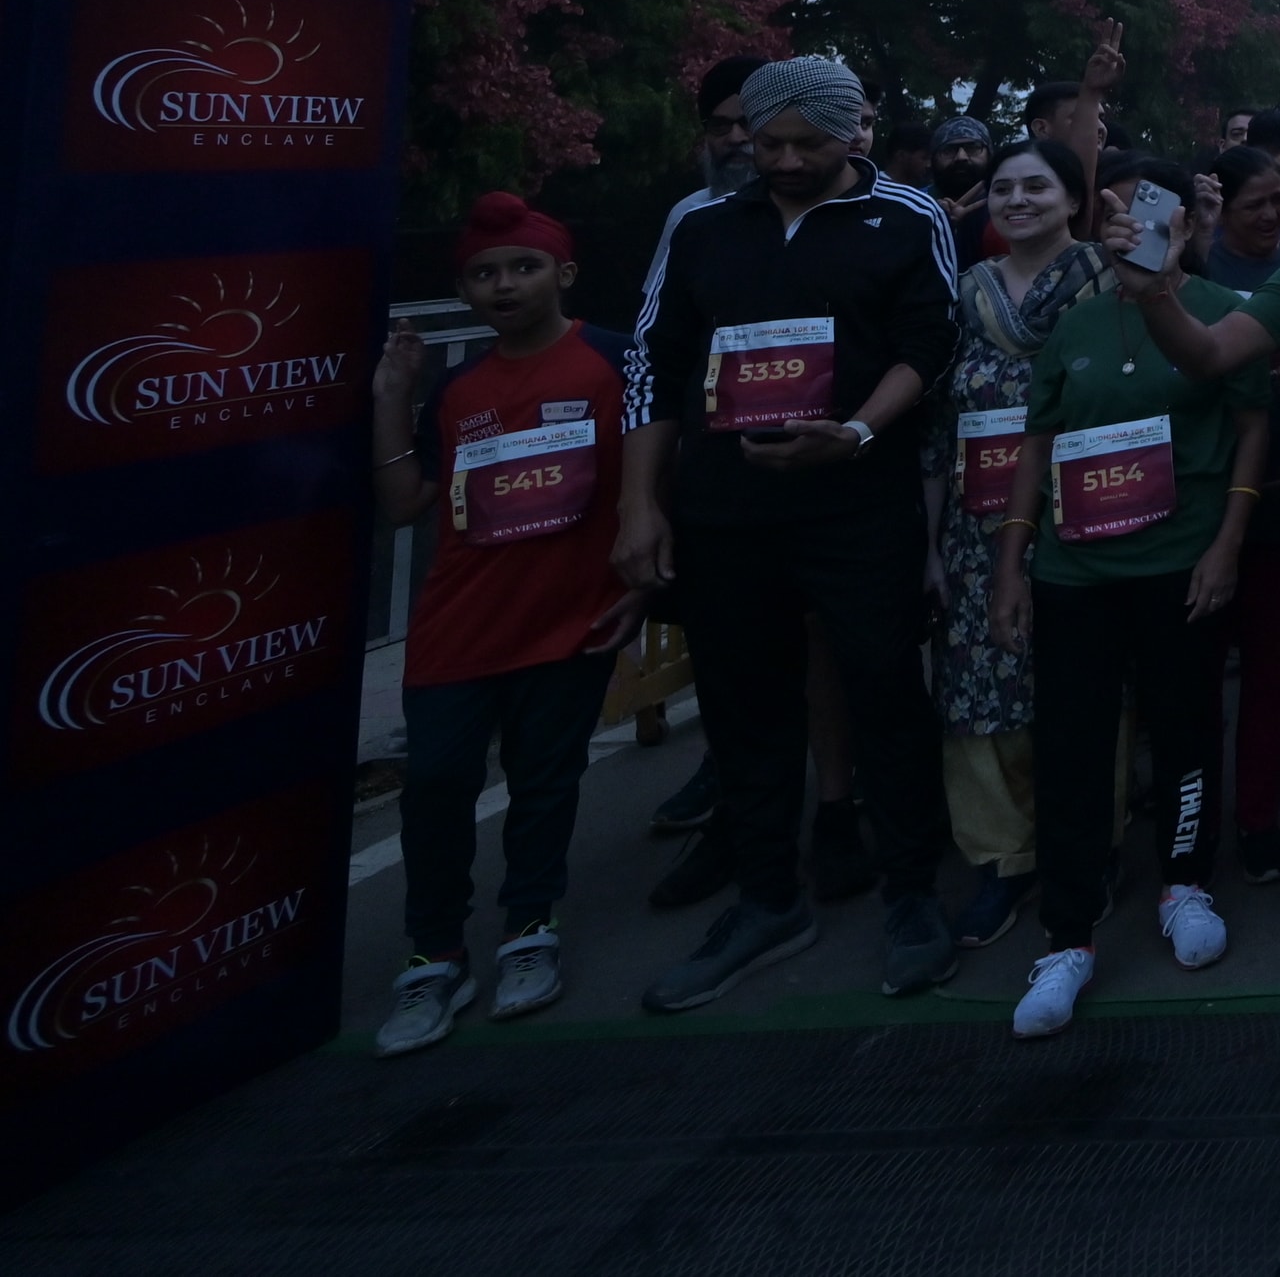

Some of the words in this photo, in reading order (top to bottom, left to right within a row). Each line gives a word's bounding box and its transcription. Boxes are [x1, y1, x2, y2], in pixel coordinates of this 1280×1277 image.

[160, 91, 250, 123] SUN
[261, 95, 364, 124] VIEW
[194, 134, 334, 146] ENCLAVE
[754, 328, 790, 337] LUDHIANA
[135, 368, 229, 411] SUN
[239, 353, 346, 393] VIEW
[737, 359, 805, 383] 5339
[171, 394, 315, 429] ENCLAVE
[735, 416, 752, 424] SUN
[755, 412, 778, 421] VIEW
[781, 408, 825, 419] ENCLAVE
[503, 435, 547, 448] LUDHIANA
[551, 432, 566, 440] 10K
[1089, 432, 1128, 443] LUDHIANA
[494, 465, 563, 496] 5413
[1083, 463, 1144, 491] 5154
[982, 499, 1002, 507] SUN
[493, 528, 512, 538] SUN
[515, 522, 541, 532] VIEW
[543, 514, 582, 528] ENCLAV
[1085, 523, 1103, 534] SUN
[1105, 518, 1127, 530] VIEW
[1129, 509, 1170, 526] ENCLAVE
[109, 653, 206, 710] SUN
[217, 616, 327, 673] VIEW
[146, 664, 295, 724] ENCLAVE
[81, 947, 180, 1021] SUN
[193, 889, 305, 966] VIEW
[118, 943, 272, 1029] ENCLAVE
